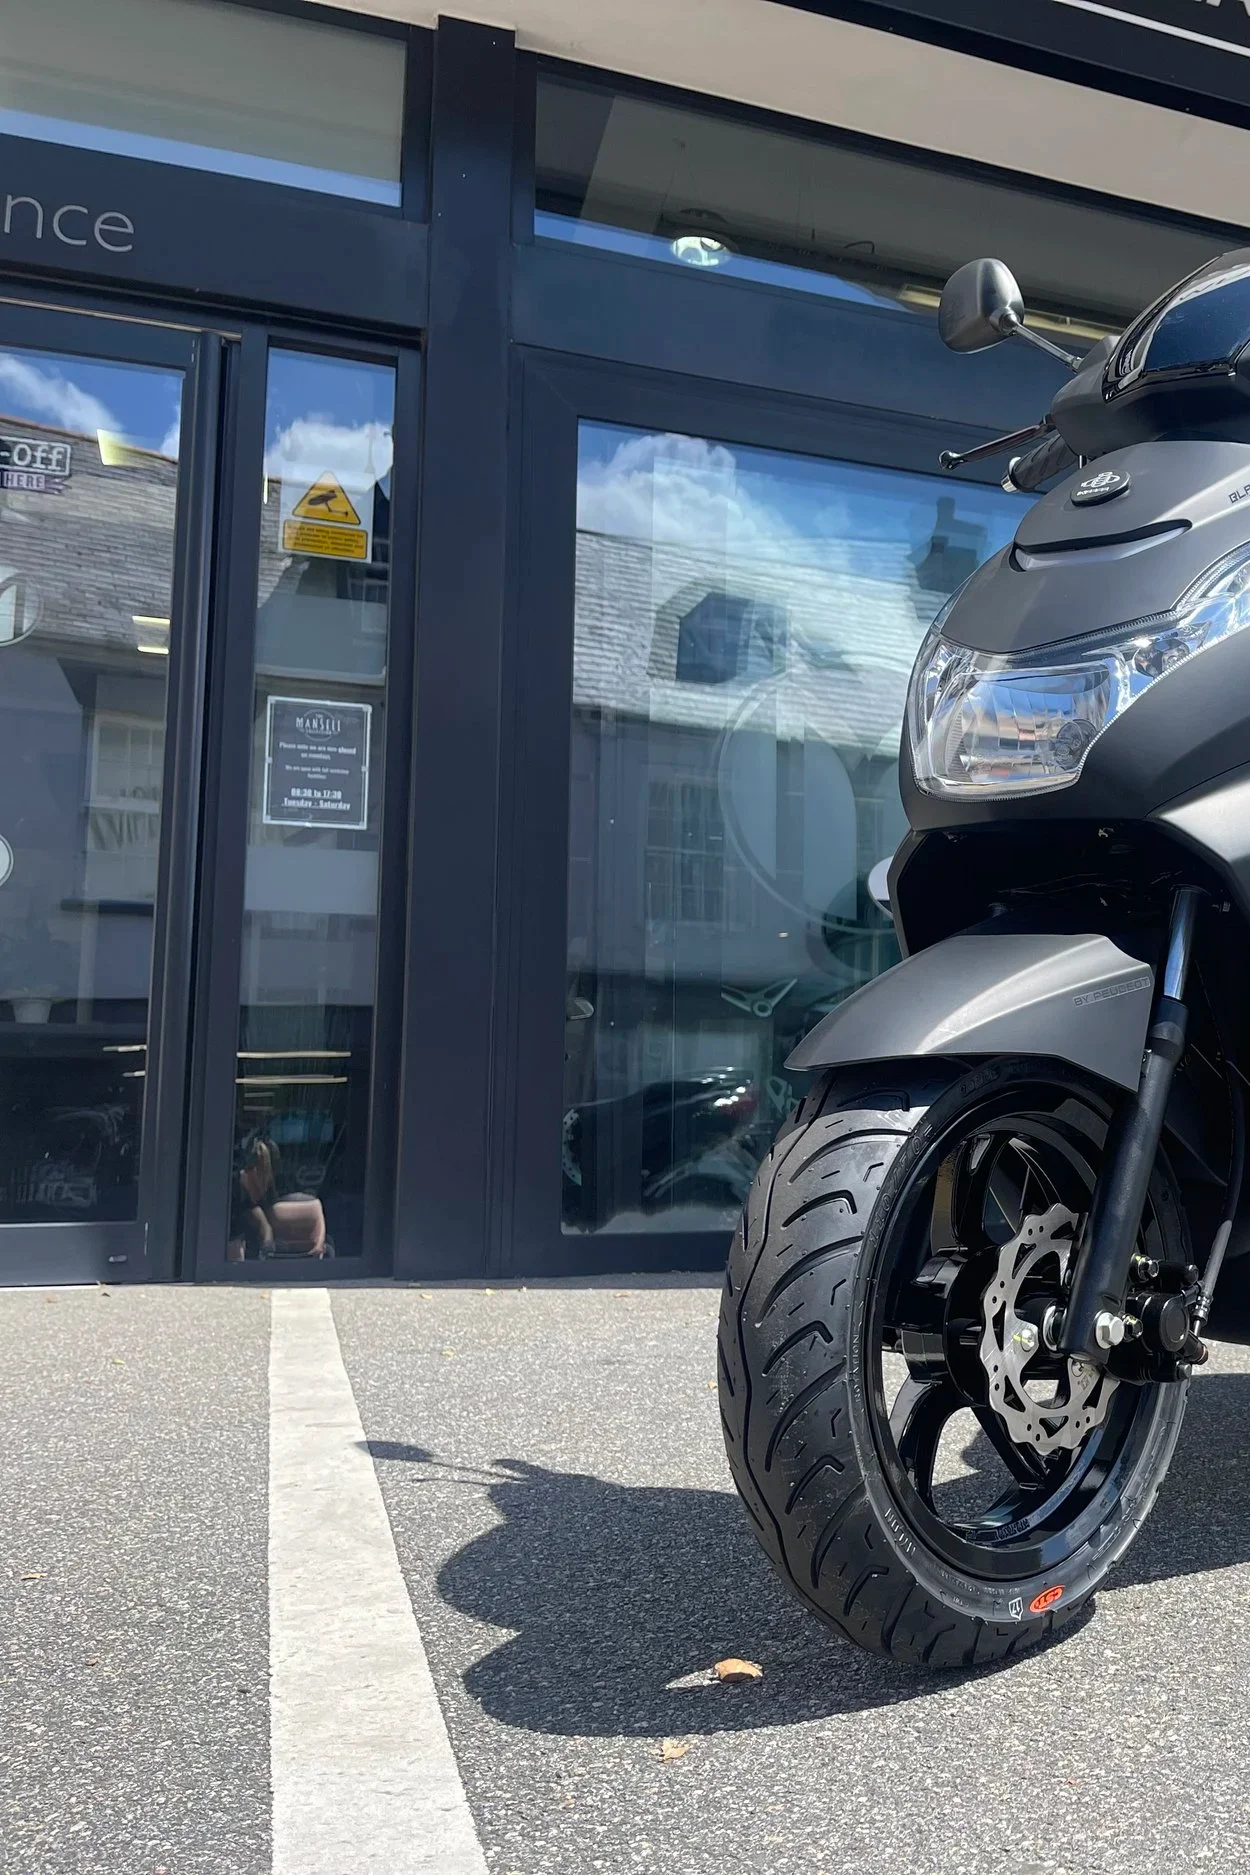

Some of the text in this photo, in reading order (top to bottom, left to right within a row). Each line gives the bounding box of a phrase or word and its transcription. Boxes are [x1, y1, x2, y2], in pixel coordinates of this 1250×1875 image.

[4, 193, 135, 252] nce
[283, 797, 312, 808] Tuesday
[319, 800, 351, 811] Saturday
